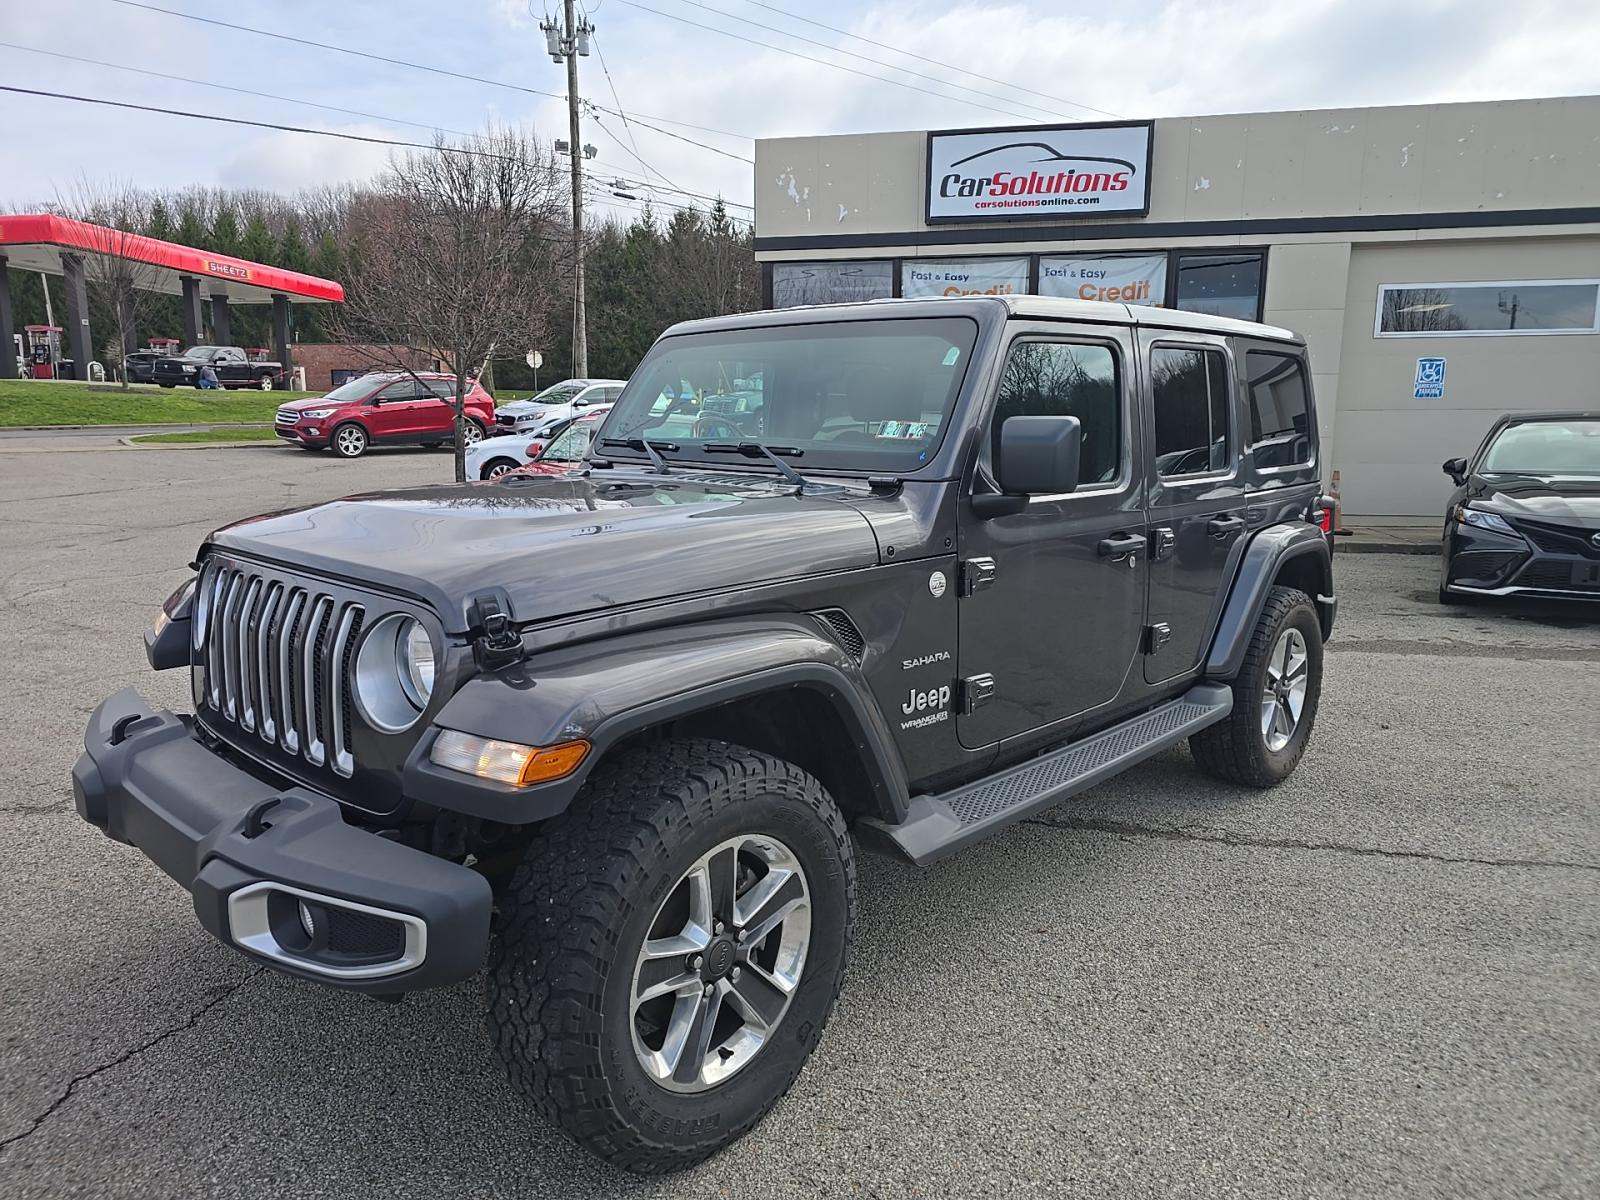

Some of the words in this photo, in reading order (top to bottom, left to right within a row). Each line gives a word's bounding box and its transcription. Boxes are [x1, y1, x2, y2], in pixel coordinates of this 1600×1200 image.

[940, 169, 1129, 198] CarSolutions
[975, 198, 1100, 209] carsolutionsonline.com
[210, 262, 246, 277] SHEETZ
[911, 271, 933, 281] Fast
[945, 273, 969, 283] Easy
[1045, 268, 1067, 278] Fast
[1080, 269, 1106, 279] Easy
[1078, 280, 1152, 301] Credit
[902, 651, 950, 670] SAHARA
[902, 685, 950, 715] Jeep
[901, 711, 948, 730] WRANGLER
